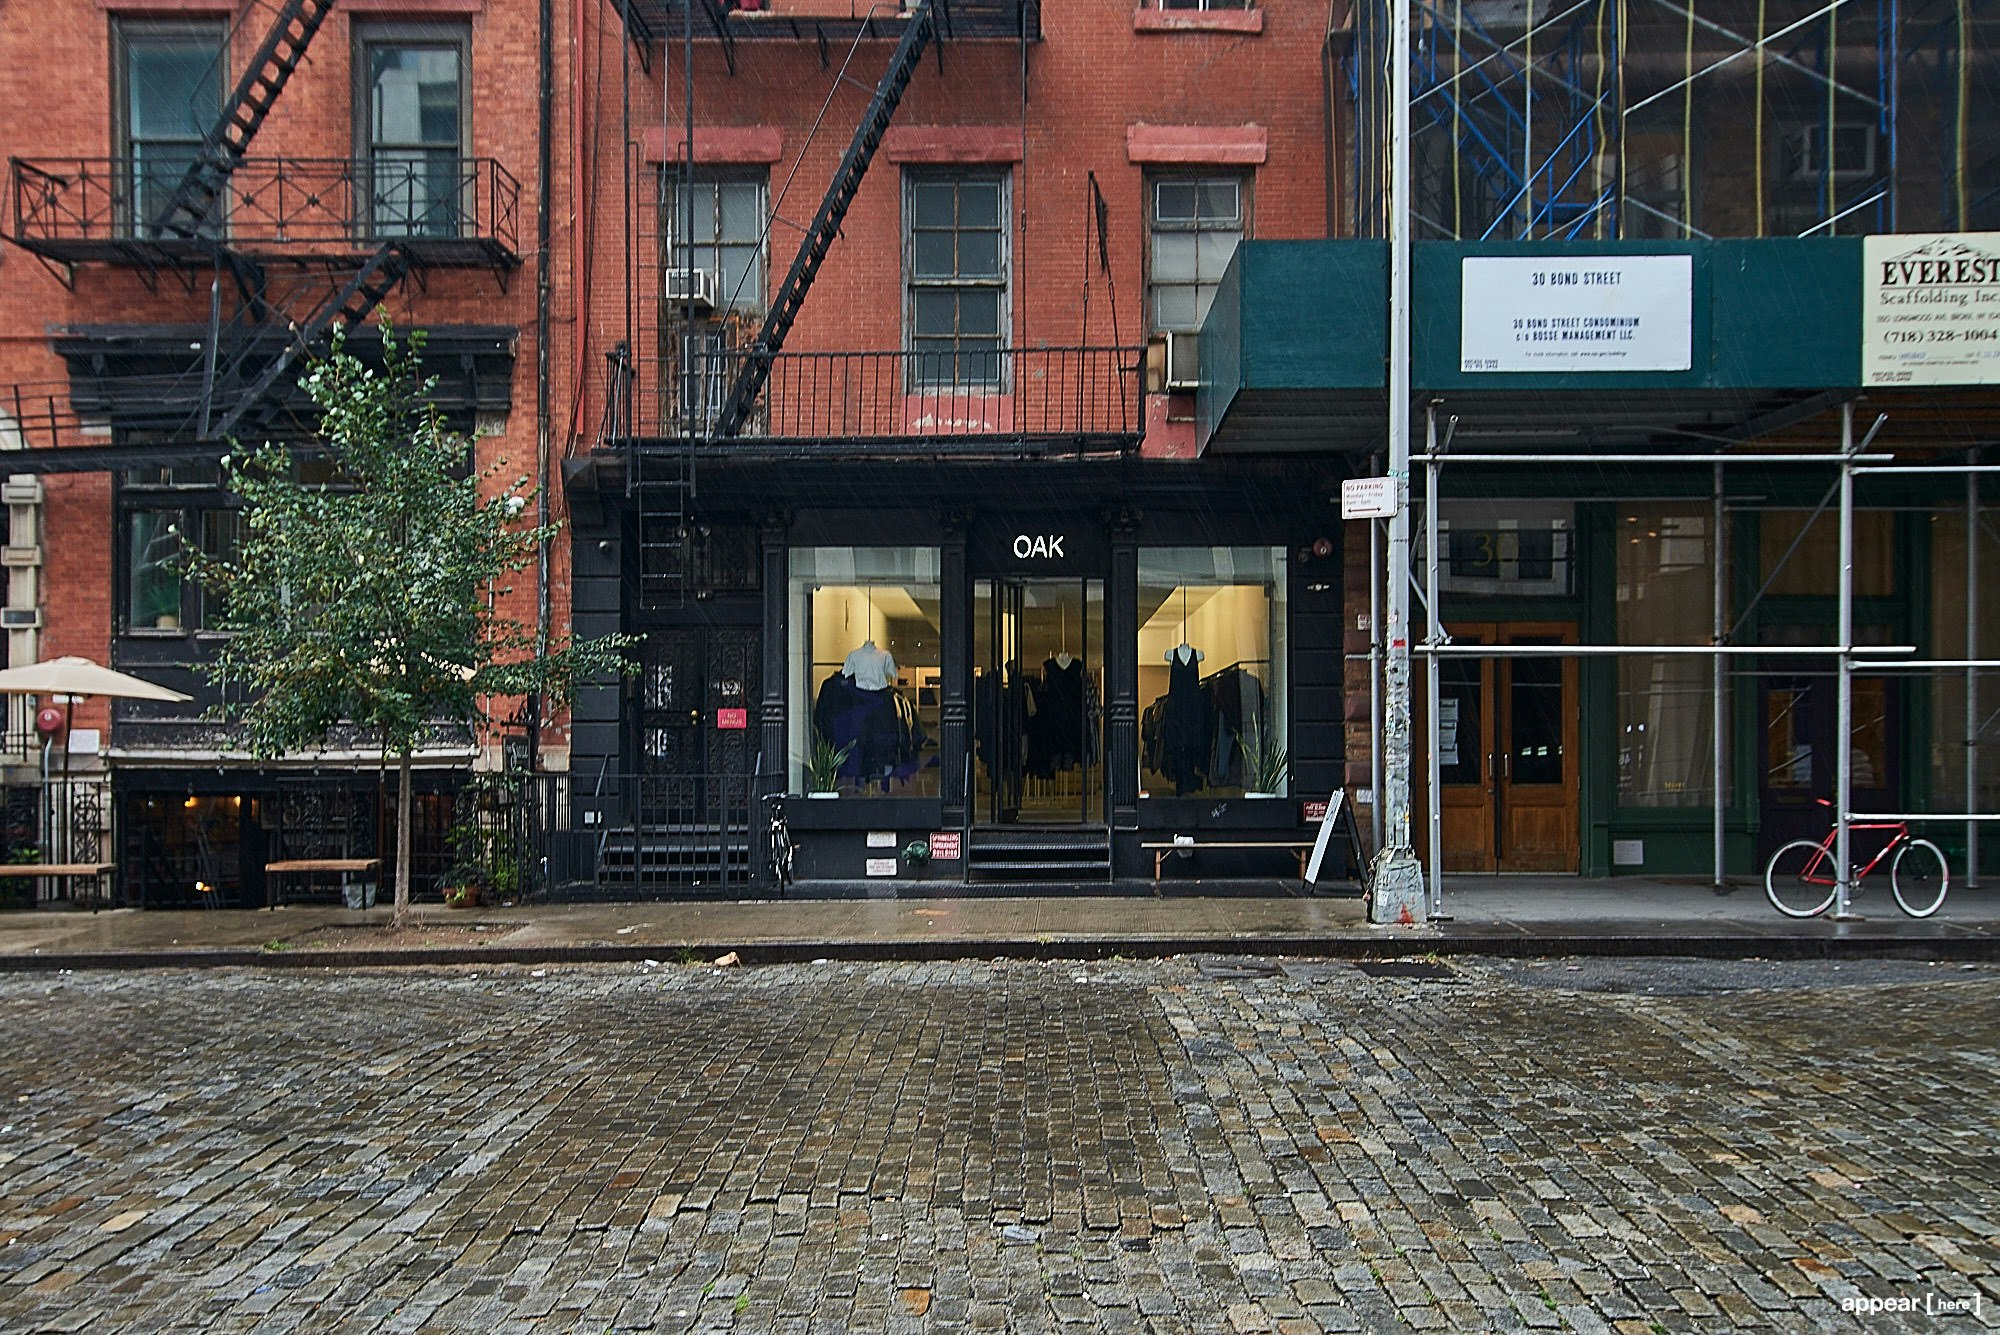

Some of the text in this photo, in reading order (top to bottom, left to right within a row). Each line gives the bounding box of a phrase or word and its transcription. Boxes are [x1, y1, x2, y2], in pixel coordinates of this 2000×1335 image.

[1532, 271, 1622, 286] 30 BOND STREET
[1881, 258, 2000, 286] EVEREST
[1880, 289, 1968, 307] Scaffolding
[1513, 316, 1640, 329] 30 BOND STREET CONDOMINIUM
[1562, 329, 1616, 341] MANAGEMENT
[1883, 330, 1924, 343] (718)
[1013, 534, 1064, 559] OAK
